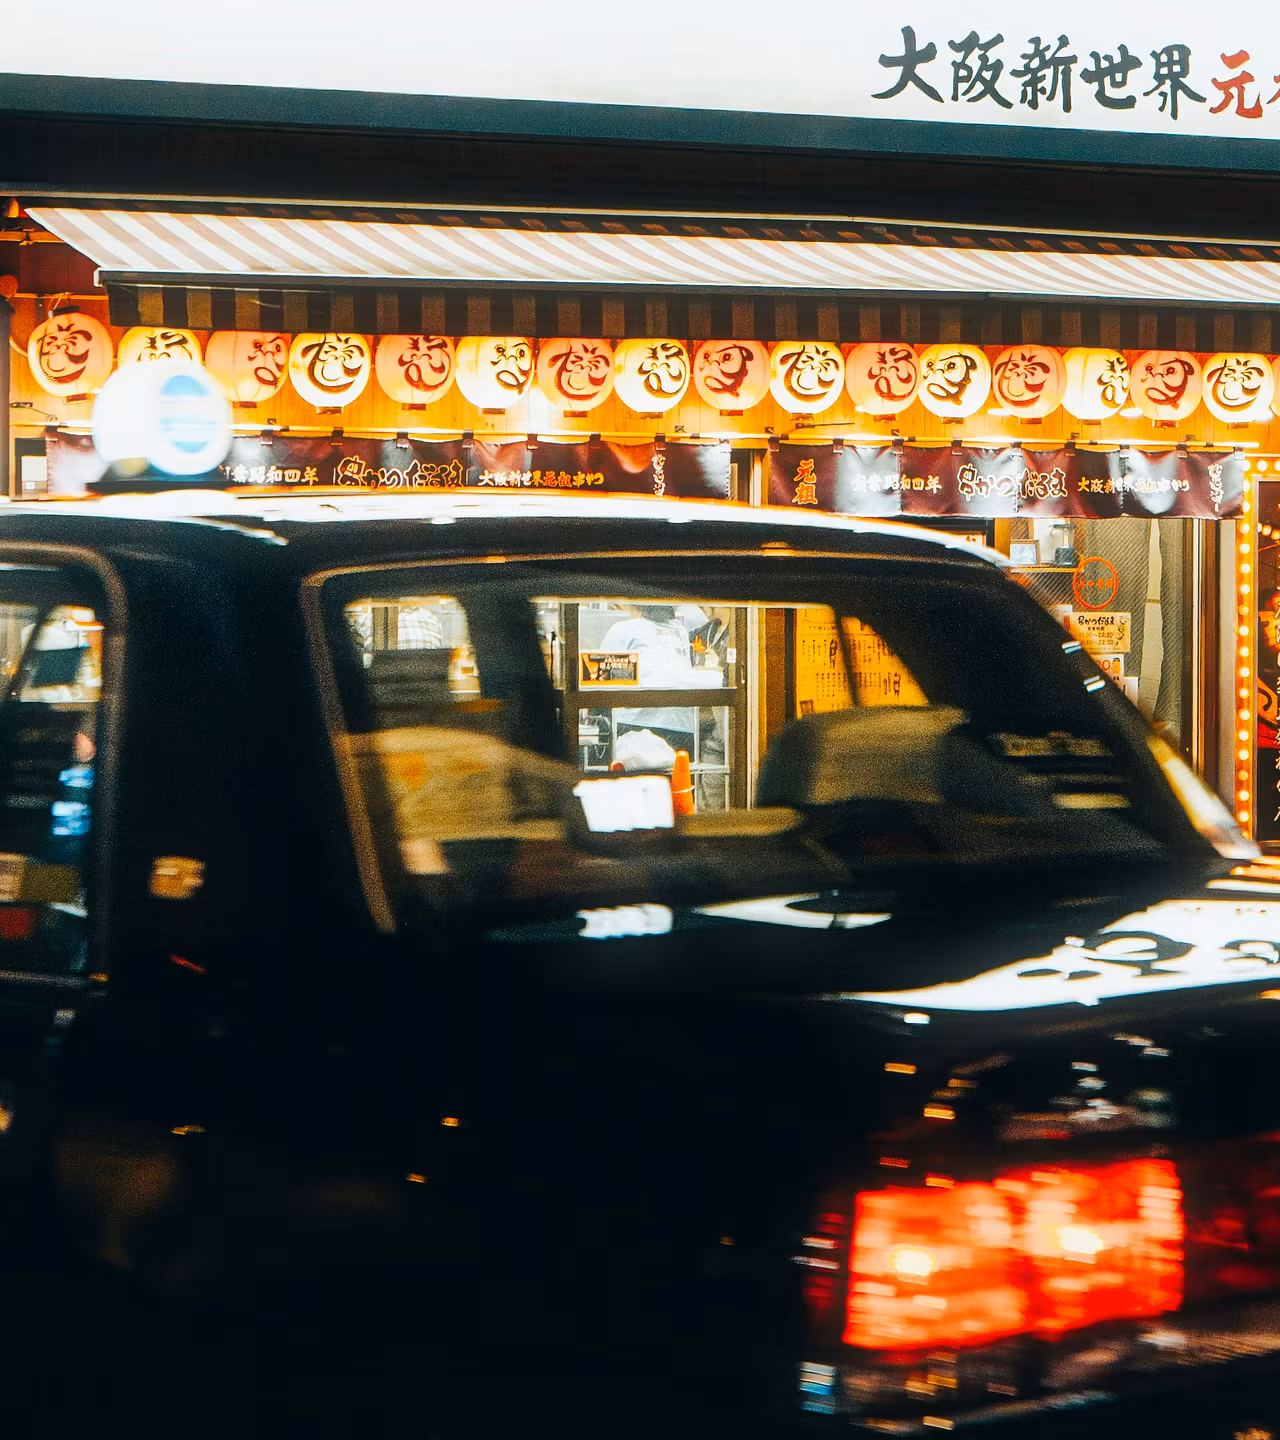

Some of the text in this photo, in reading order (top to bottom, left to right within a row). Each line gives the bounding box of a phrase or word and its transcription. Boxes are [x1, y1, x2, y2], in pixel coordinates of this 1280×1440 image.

[221, 465, 320, 487] 業昭和四年
[792, 459, 819, 506] 元祖
[955, 463, 1070, 501] 串かつだるま
